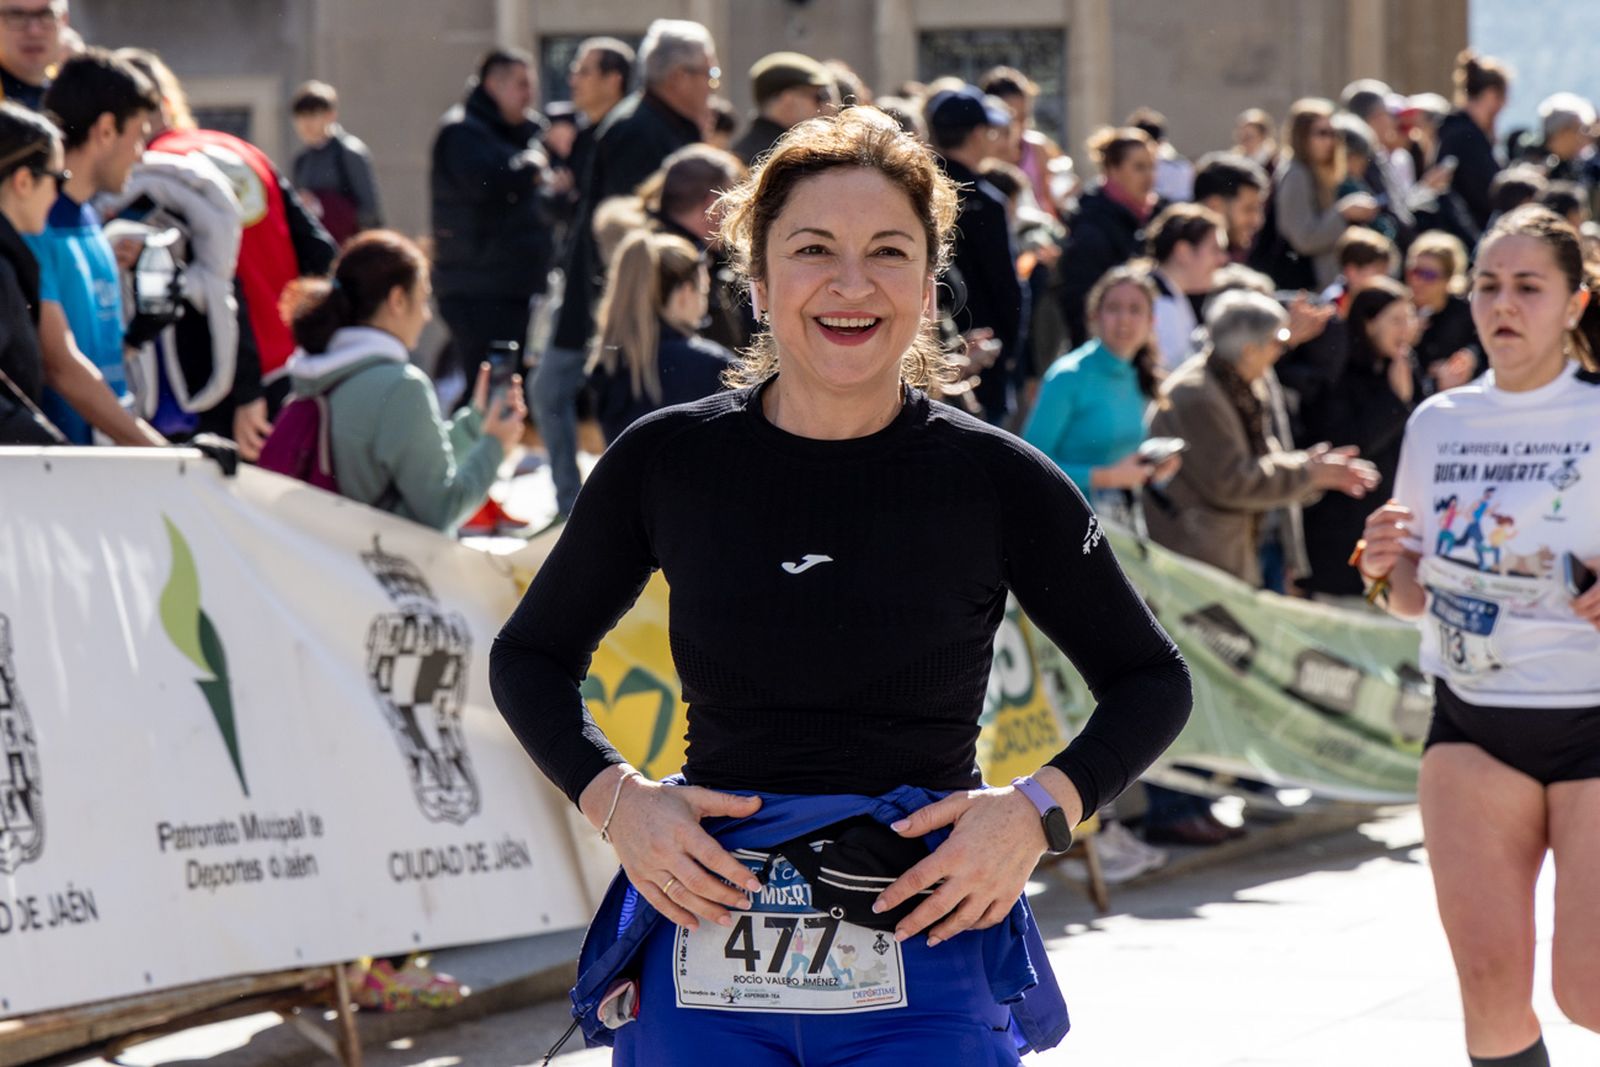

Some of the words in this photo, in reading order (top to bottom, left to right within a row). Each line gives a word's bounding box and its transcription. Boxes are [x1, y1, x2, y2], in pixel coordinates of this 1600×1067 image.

[1450, 441, 1509, 456] CARRERA
[1513, 441, 1591, 456] CAMINATA
[1433, 462, 1478, 484] BUENA
[1481, 461, 1549, 483] MUERTE
[186, 856, 265, 894] Deportes
[760, 884, 813, 906] MUERT
[723, 915, 841, 974] 477
[733, 974, 764, 985] ROCÍO
[765, 976, 800, 987] VALERO
[802, 976, 840, 988] JIMÉNEZ
